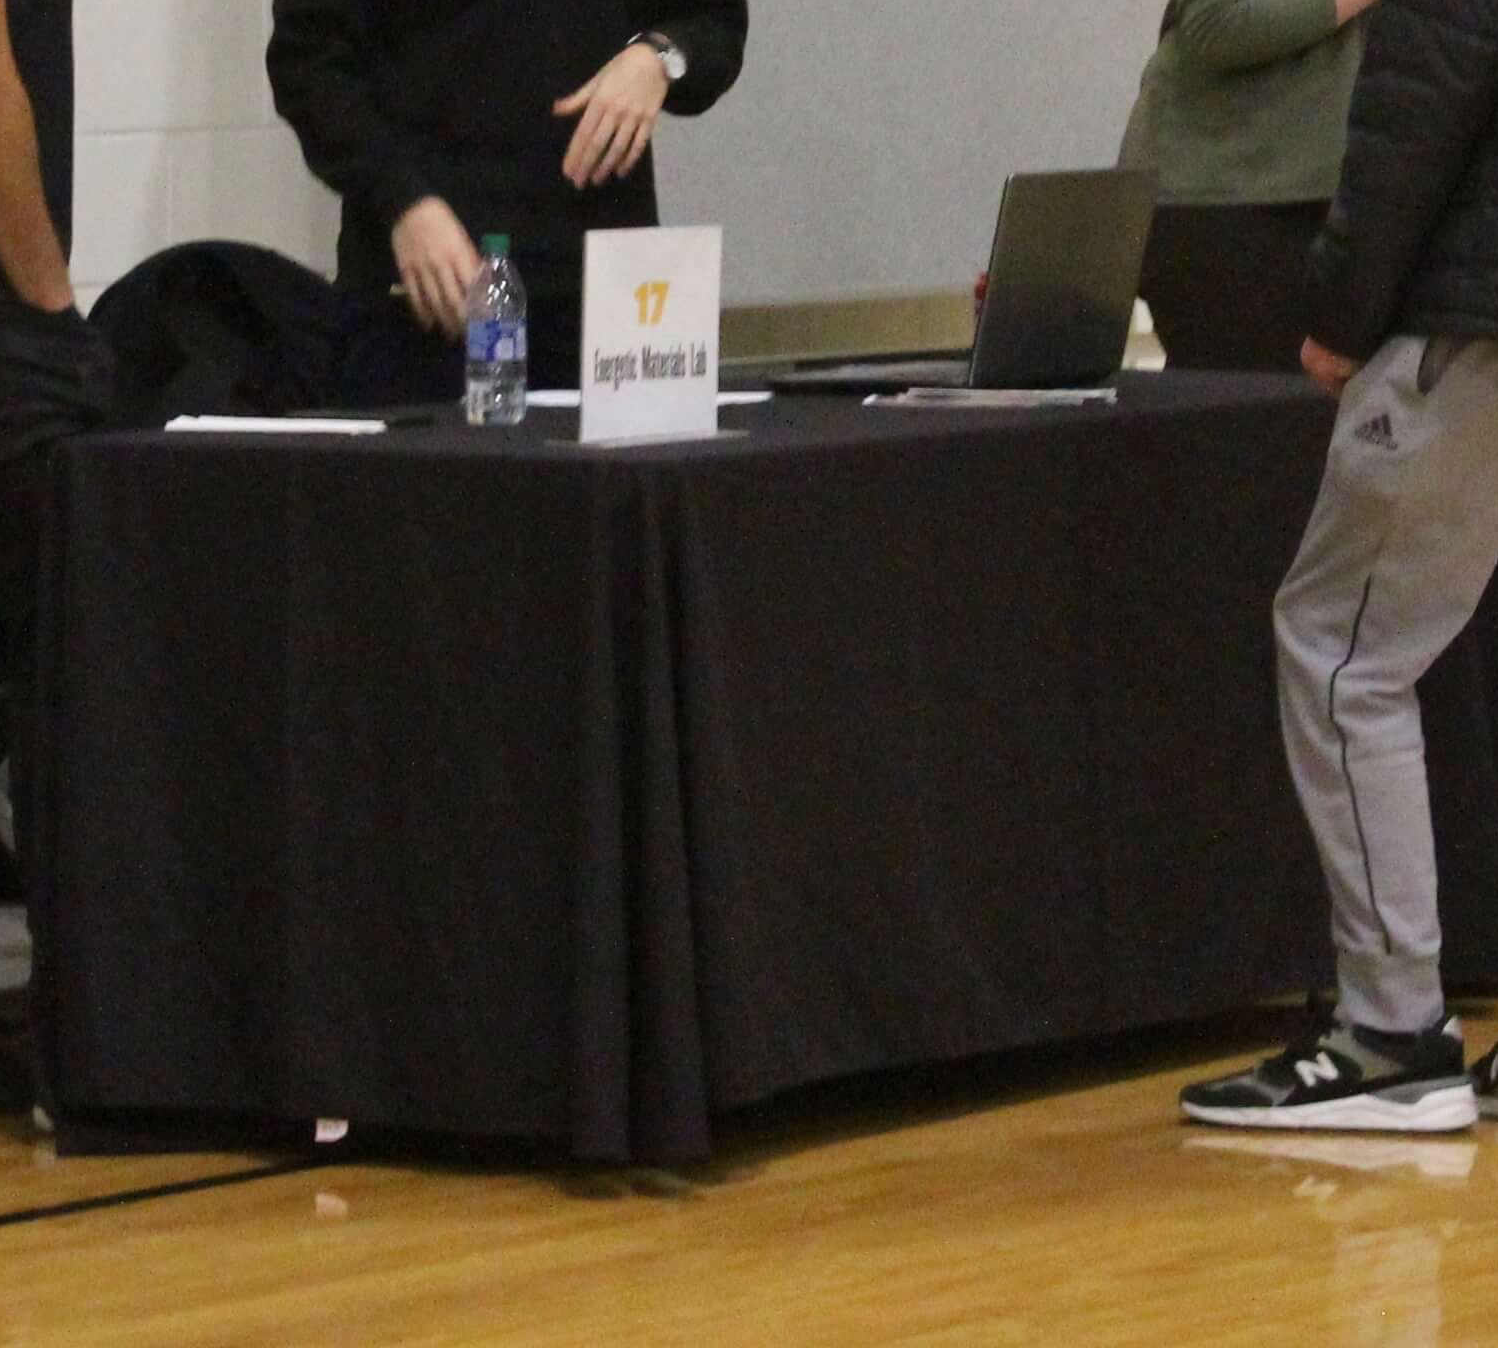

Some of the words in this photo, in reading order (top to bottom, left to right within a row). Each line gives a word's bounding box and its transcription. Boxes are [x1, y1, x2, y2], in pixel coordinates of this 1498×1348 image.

[634, 281, 670, 325] 17
[593, 348, 637, 392] Energetic
[642, 344, 685, 382] Materials
[689, 341, 707, 377] Lab
